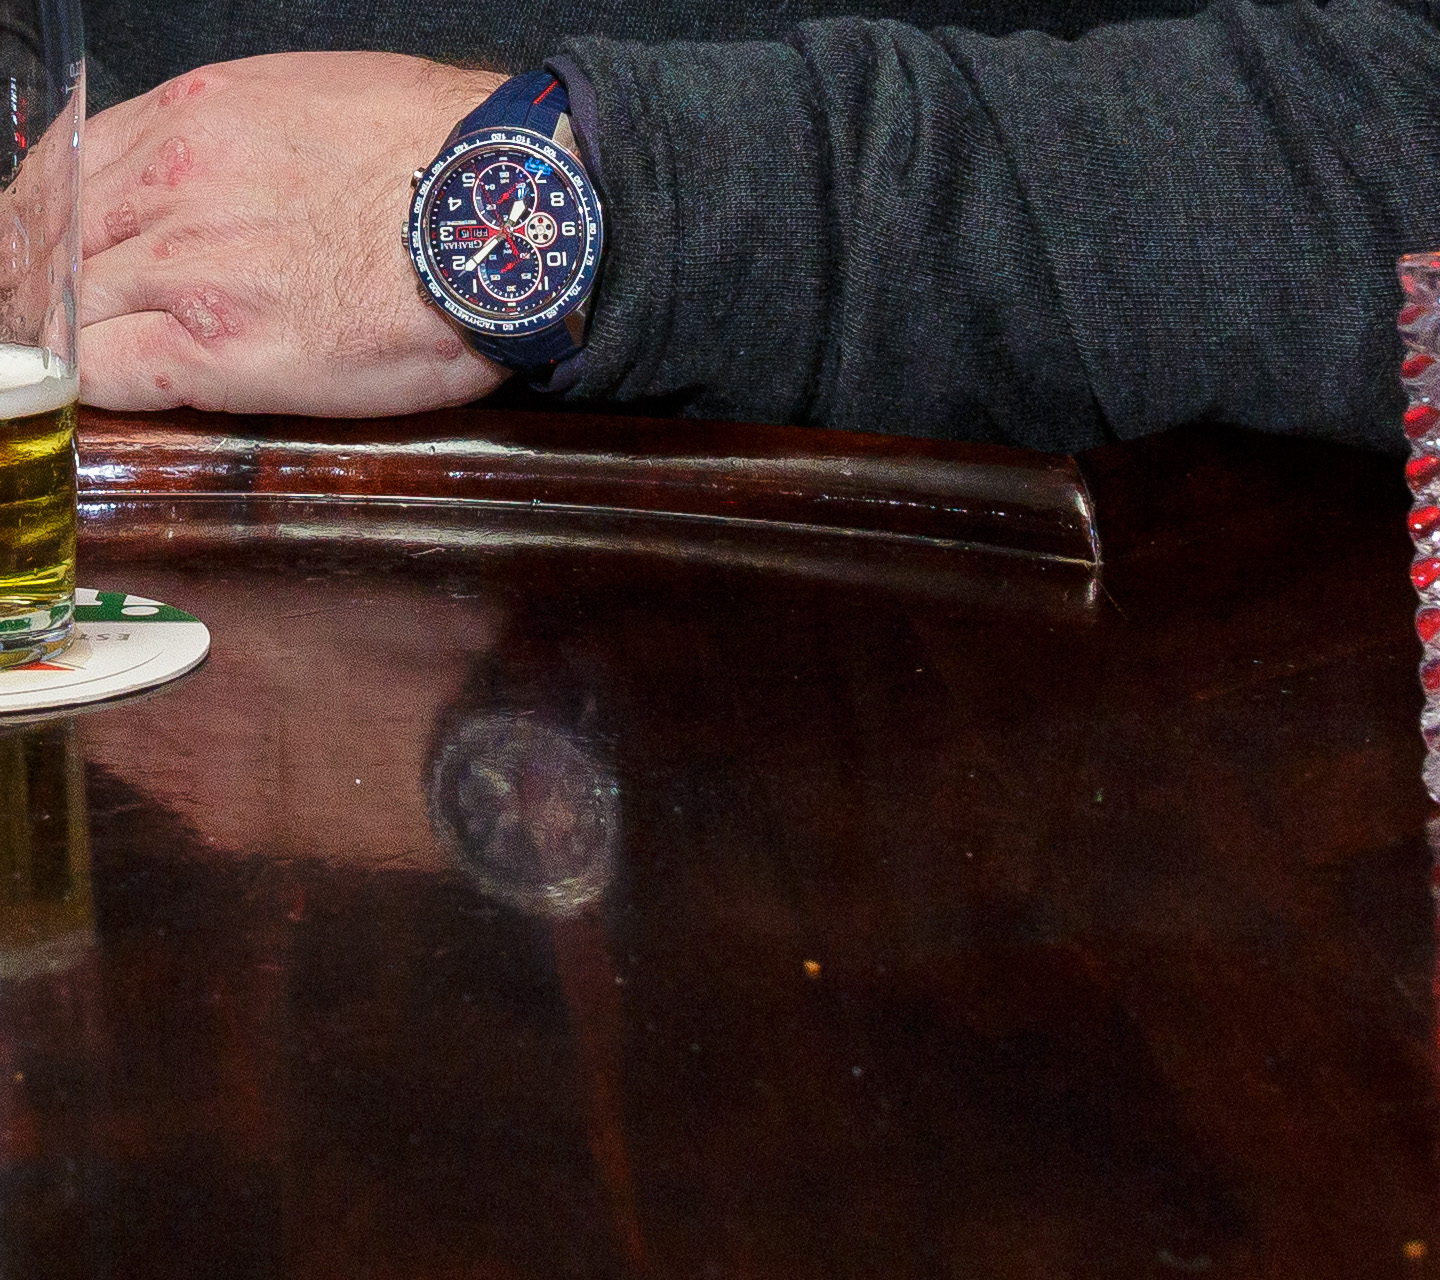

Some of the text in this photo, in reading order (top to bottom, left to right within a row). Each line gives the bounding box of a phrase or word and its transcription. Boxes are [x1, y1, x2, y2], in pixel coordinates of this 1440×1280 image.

[462, 172, 475, 187] 5
[535, 169, 547, 184] 7
[448, 197, 462, 211] 4
[550, 192, 565, 207] 8
[440, 227, 453, 241] 3
[561, 221, 575, 236] 9
[440, 240, 482, 249] GRAHAM
[452, 255, 466, 270] 2
[546, 251, 567, 266] 10
[444, 300, 495, 330] TACHYMETER
